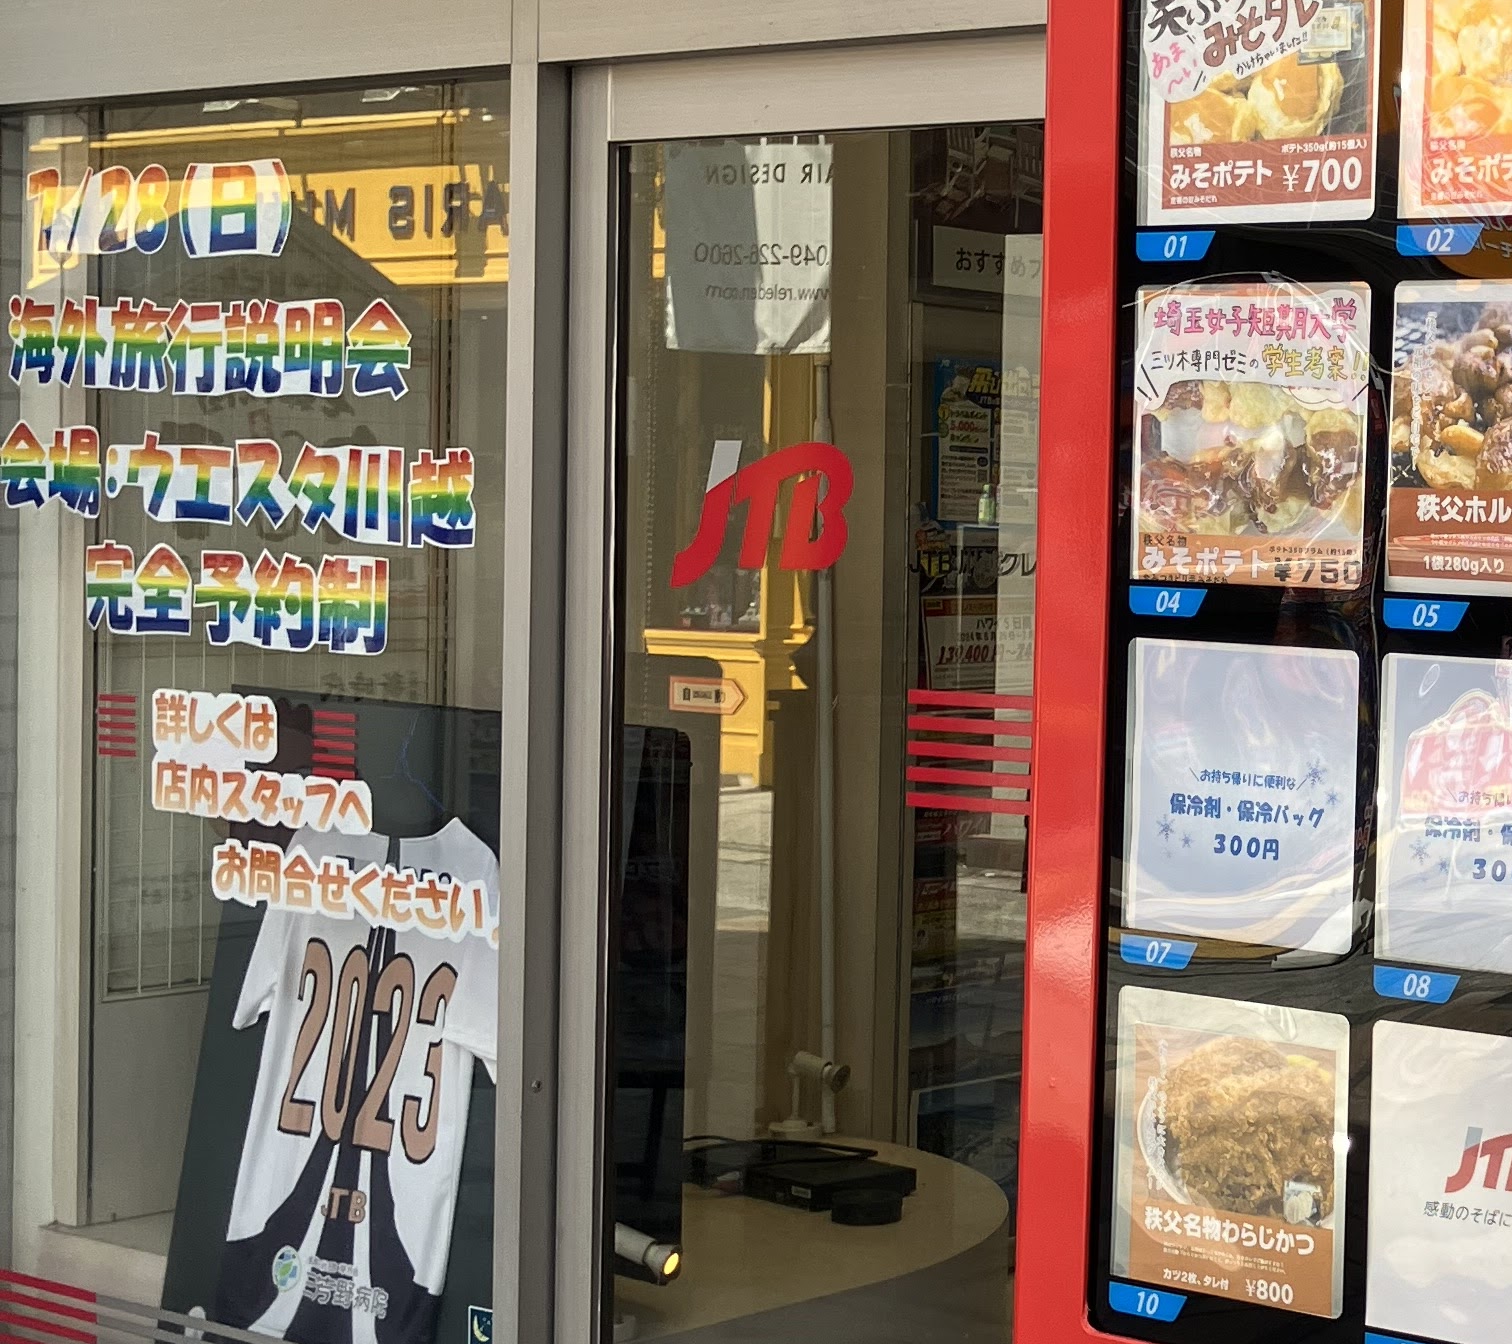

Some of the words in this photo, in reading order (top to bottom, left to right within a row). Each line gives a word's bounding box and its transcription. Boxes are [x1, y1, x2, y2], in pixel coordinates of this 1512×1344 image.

[1170, 159, 1273, 190] みそポテト
[1282, 156, 1363, 193] ¥700
[1163, 235, 1189, 259] 01
[1426, 228, 1452, 253] 02
[1154, 297, 1357, 342] 埼玉女子短期大学
[8, 296, 413, 400] 海外旅行説明会
[670, 439, 854, 589] JTB
[1142, 546, 1269, 579] みそポテト
[1274, 556, 1362, 586] ¥750
[1423, 555, 1505, 575] 1袋280g入り
[86, 541, 390, 655] 完全予約制
[1156, 591, 1181, 613] 04
[1412, 604, 1440, 628] 05
[153, 690, 277, 763] 詳しくは
[1200, 769, 1296, 790] お持ち帰りに便利な
[153, 760, 372, 834] 店内スタッフへ
[1170, 792, 1325, 829] 保冷剤・保冷バッグ
[1213, 834, 1279, 861] 300円
[1145, 941, 1172, 964] 07
[1403, 973, 1432, 998] 08
[278, 937, 459, 1164] 2023
[1144, 1206, 1316, 1256] 秩父名物わらじかつ
[1163, 1267, 1229, 1291] カツ2枚、タレ付
[1245, 1278, 1294, 1306] ¥800
[1136, 1291, 1159, 1316] 10
